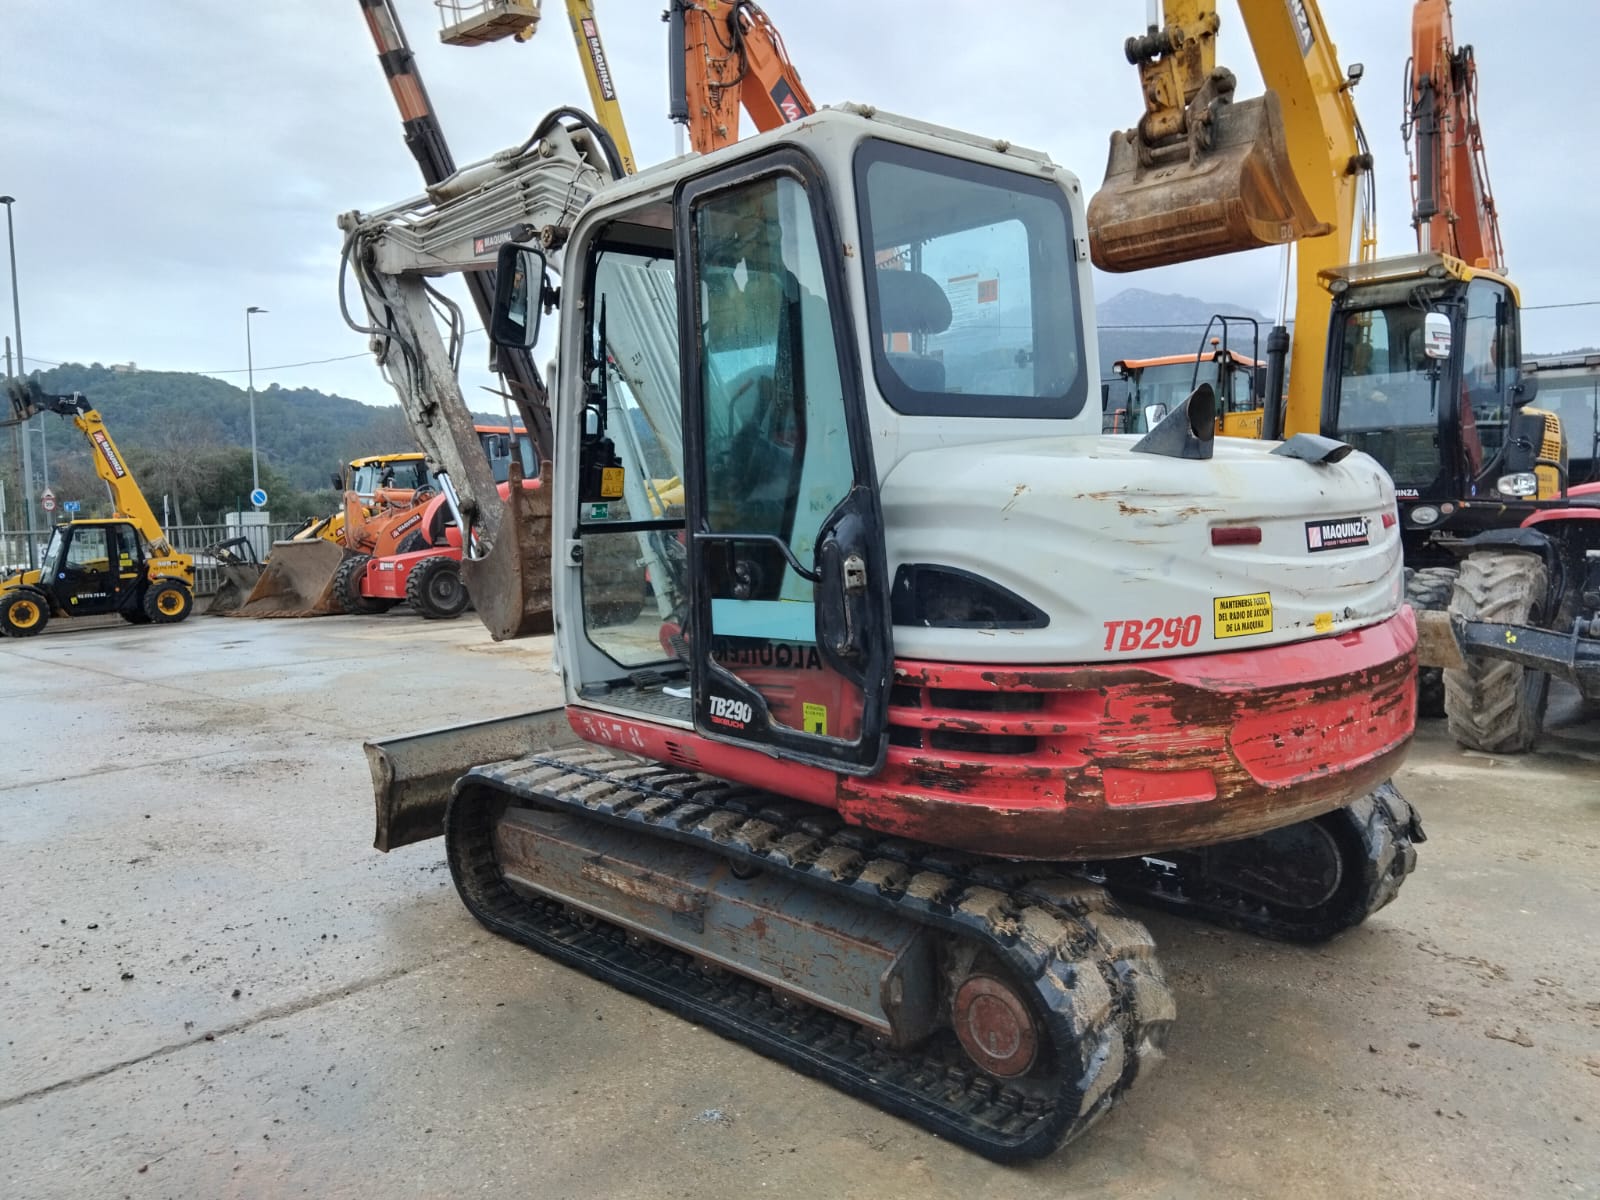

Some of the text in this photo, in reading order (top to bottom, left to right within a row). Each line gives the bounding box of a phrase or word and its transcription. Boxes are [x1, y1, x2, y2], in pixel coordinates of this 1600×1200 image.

[590, 37, 613, 99] MAQUINZA
[1322, 521, 1367, 539] MAQUINZA
[1220, 599, 1253, 610] MANTENERSE
[1218, 613, 1228, 622] DEL
[1229, 610, 1246, 621] RADIO
[1246, 609, 1253, 619] DE
[1103, 614, 1202, 652] TB290
[1226, 623, 1233, 632] DE
[1234, 622, 1241, 632] LA
[709, 695, 752, 724] TB290
